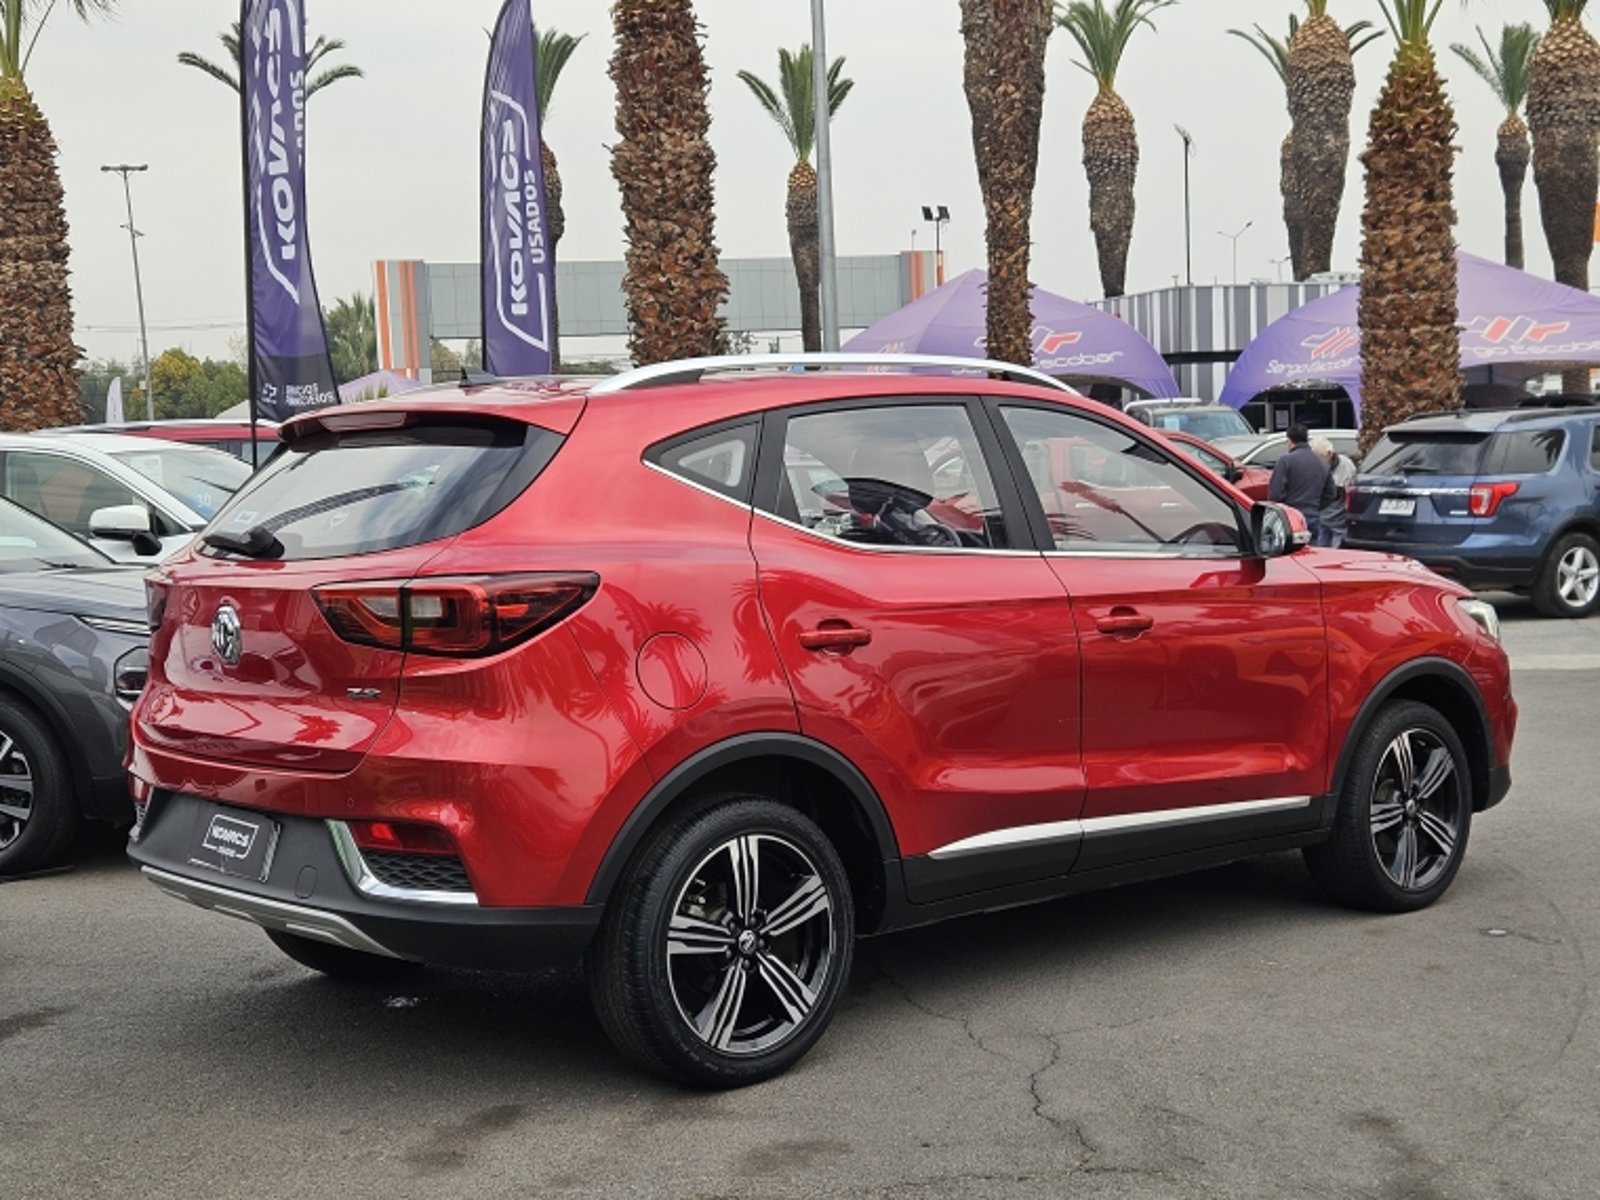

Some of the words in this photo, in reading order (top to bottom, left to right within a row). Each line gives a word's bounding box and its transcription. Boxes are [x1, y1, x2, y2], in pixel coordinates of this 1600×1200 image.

[264, 7, 297, 261] KOVACS
[500, 118, 529, 316] KOVACS
[523, 169, 546, 265] USADOS
